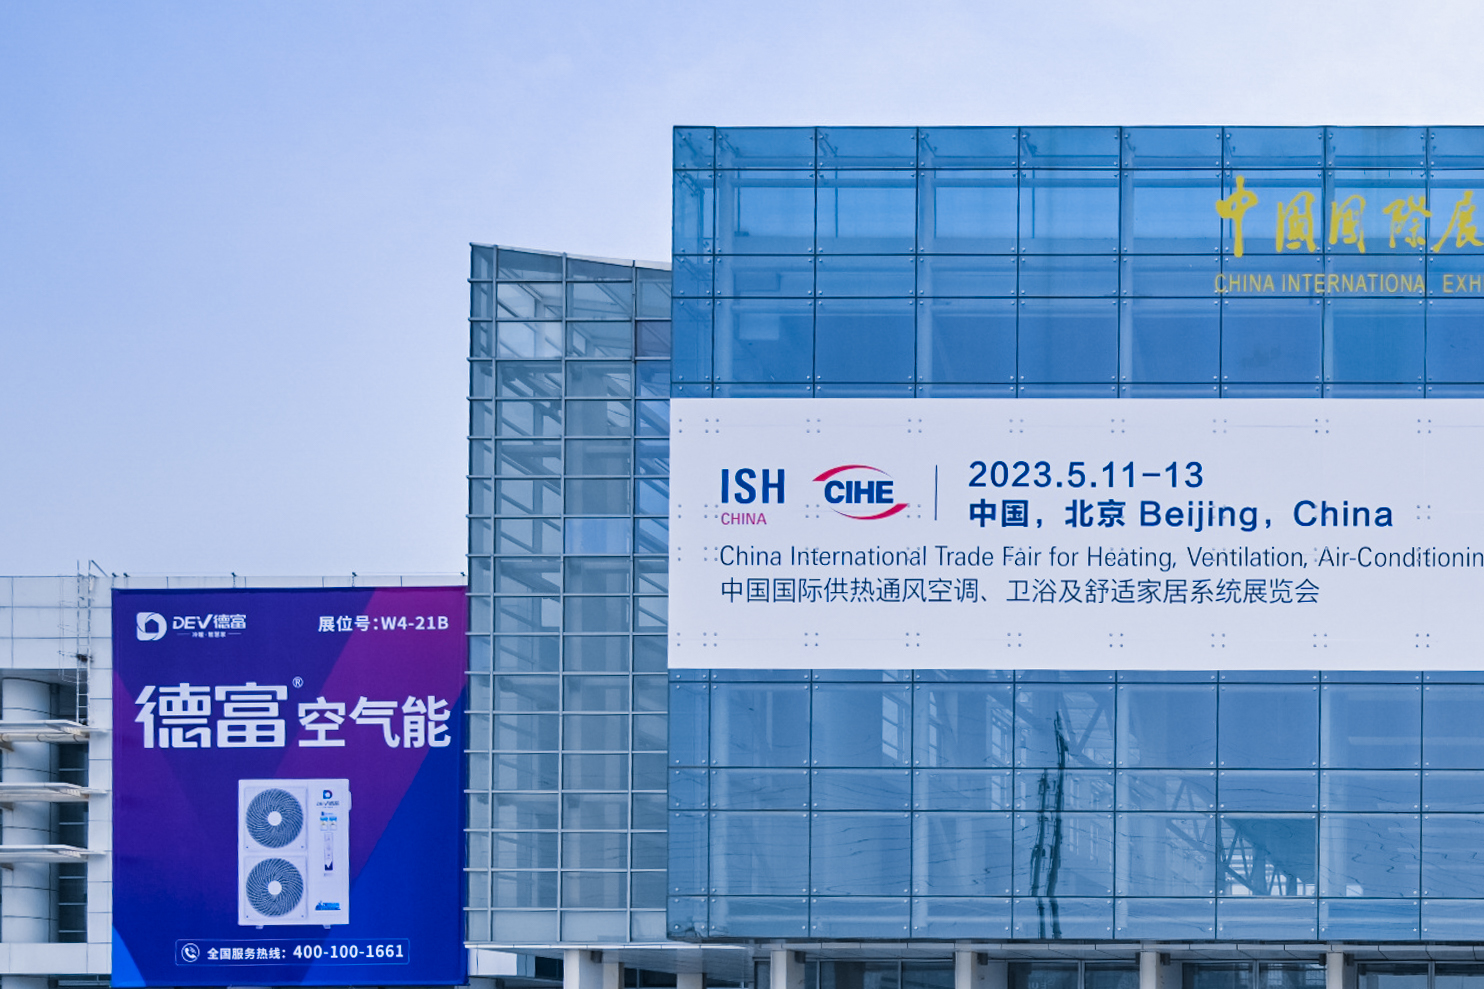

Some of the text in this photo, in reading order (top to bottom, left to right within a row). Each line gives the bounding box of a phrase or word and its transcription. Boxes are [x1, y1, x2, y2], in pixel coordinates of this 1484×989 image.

[1214, 273, 1275, 293] CHINA
[721, 467, 785, 505] ISH
[968, 461, 1203, 488] 2023.5.11-13
[824, 480, 894, 504] CIHE
[720, 512, 767, 526] CHINA
[1293, 499, 1393, 528] China
[719, 544, 782, 566] China
[791, 544, 927, 567] International
[934, 545, 994, 567] Trade
[1003, 545, 1042, 567] Fair
[1048, 545, 1079, 567] for
[1087, 546, 1177, 572] Heating,
[1186, 546, 1308, 571] Ventilation,
[719, 577, 1321, 605] 中国国际供热通风空调、卫浴及舒适家居系统展览会
[134, 682, 452, 749] 德富 空气能
[292, 944, 404, 959] 400-100-1661
